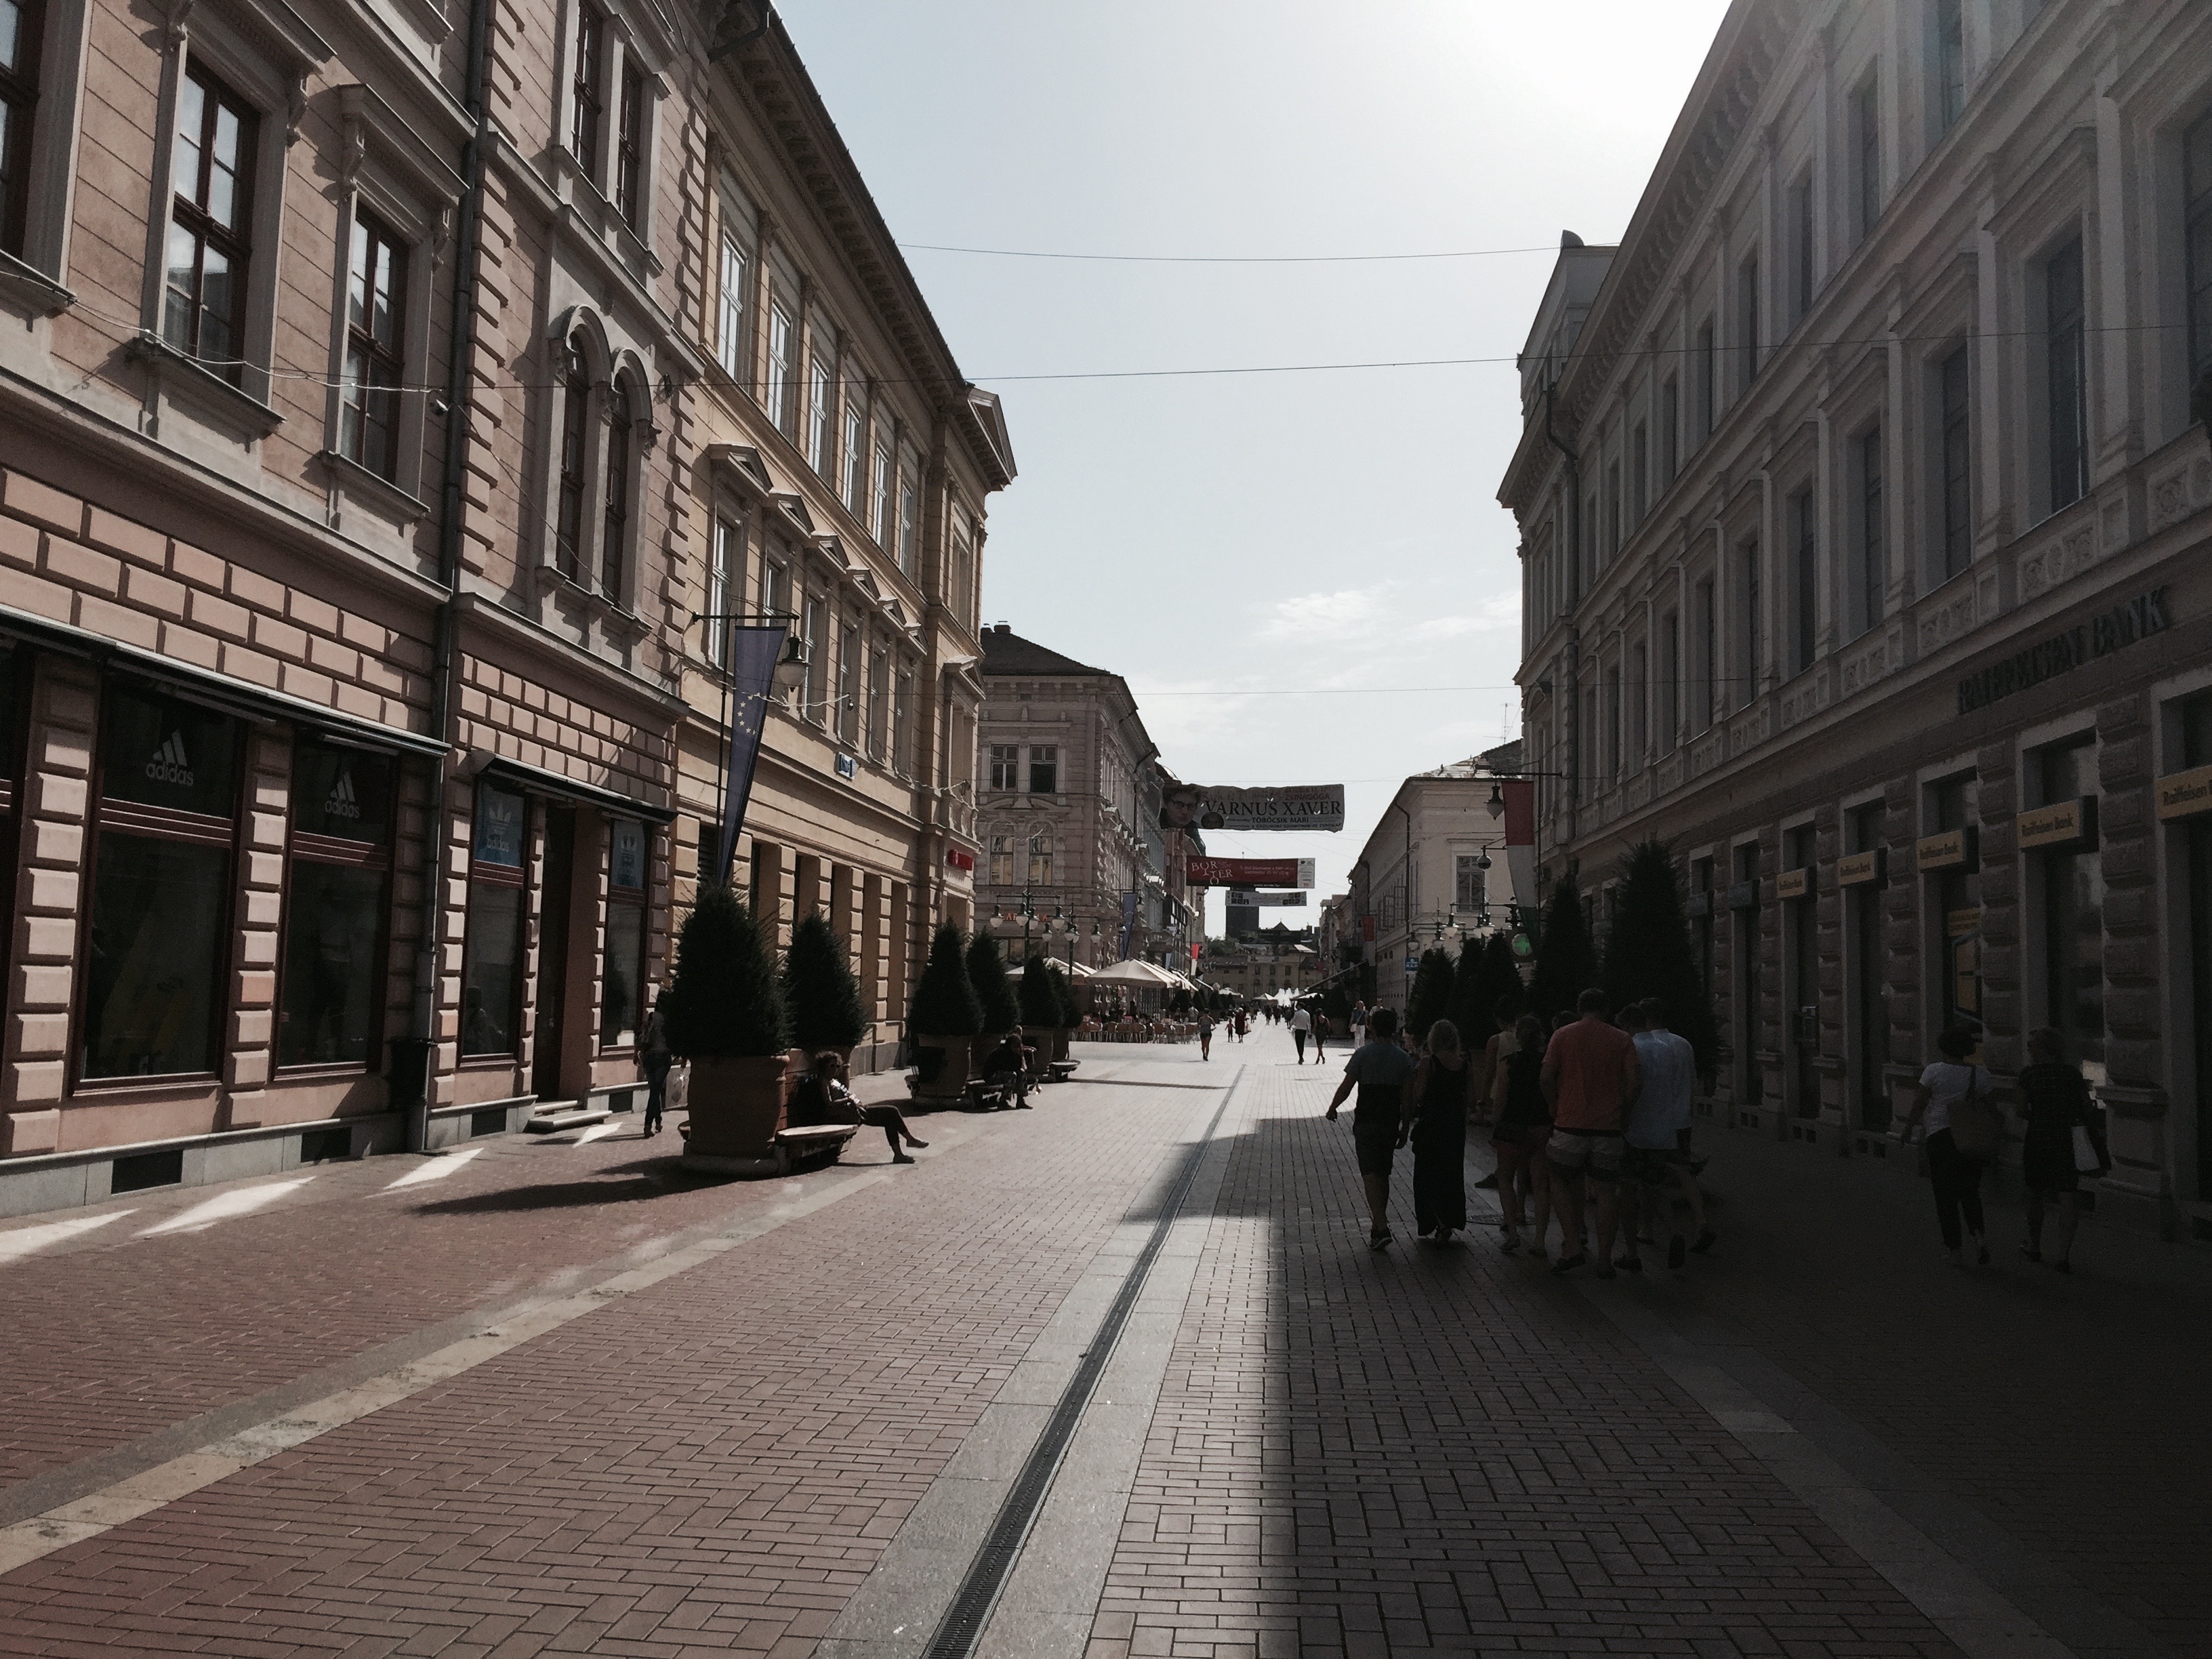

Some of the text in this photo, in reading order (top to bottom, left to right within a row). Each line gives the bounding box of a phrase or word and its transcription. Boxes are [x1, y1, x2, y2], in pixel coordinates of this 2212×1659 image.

[2092, 584, 2171, 657] BANK
[146, 762, 194, 787] adidas
[325, 798, 360, 819] adidas
[1205, 800, 1342, 817] VARNUS XAVER
[2054, 813, 2073, 830] Bank
